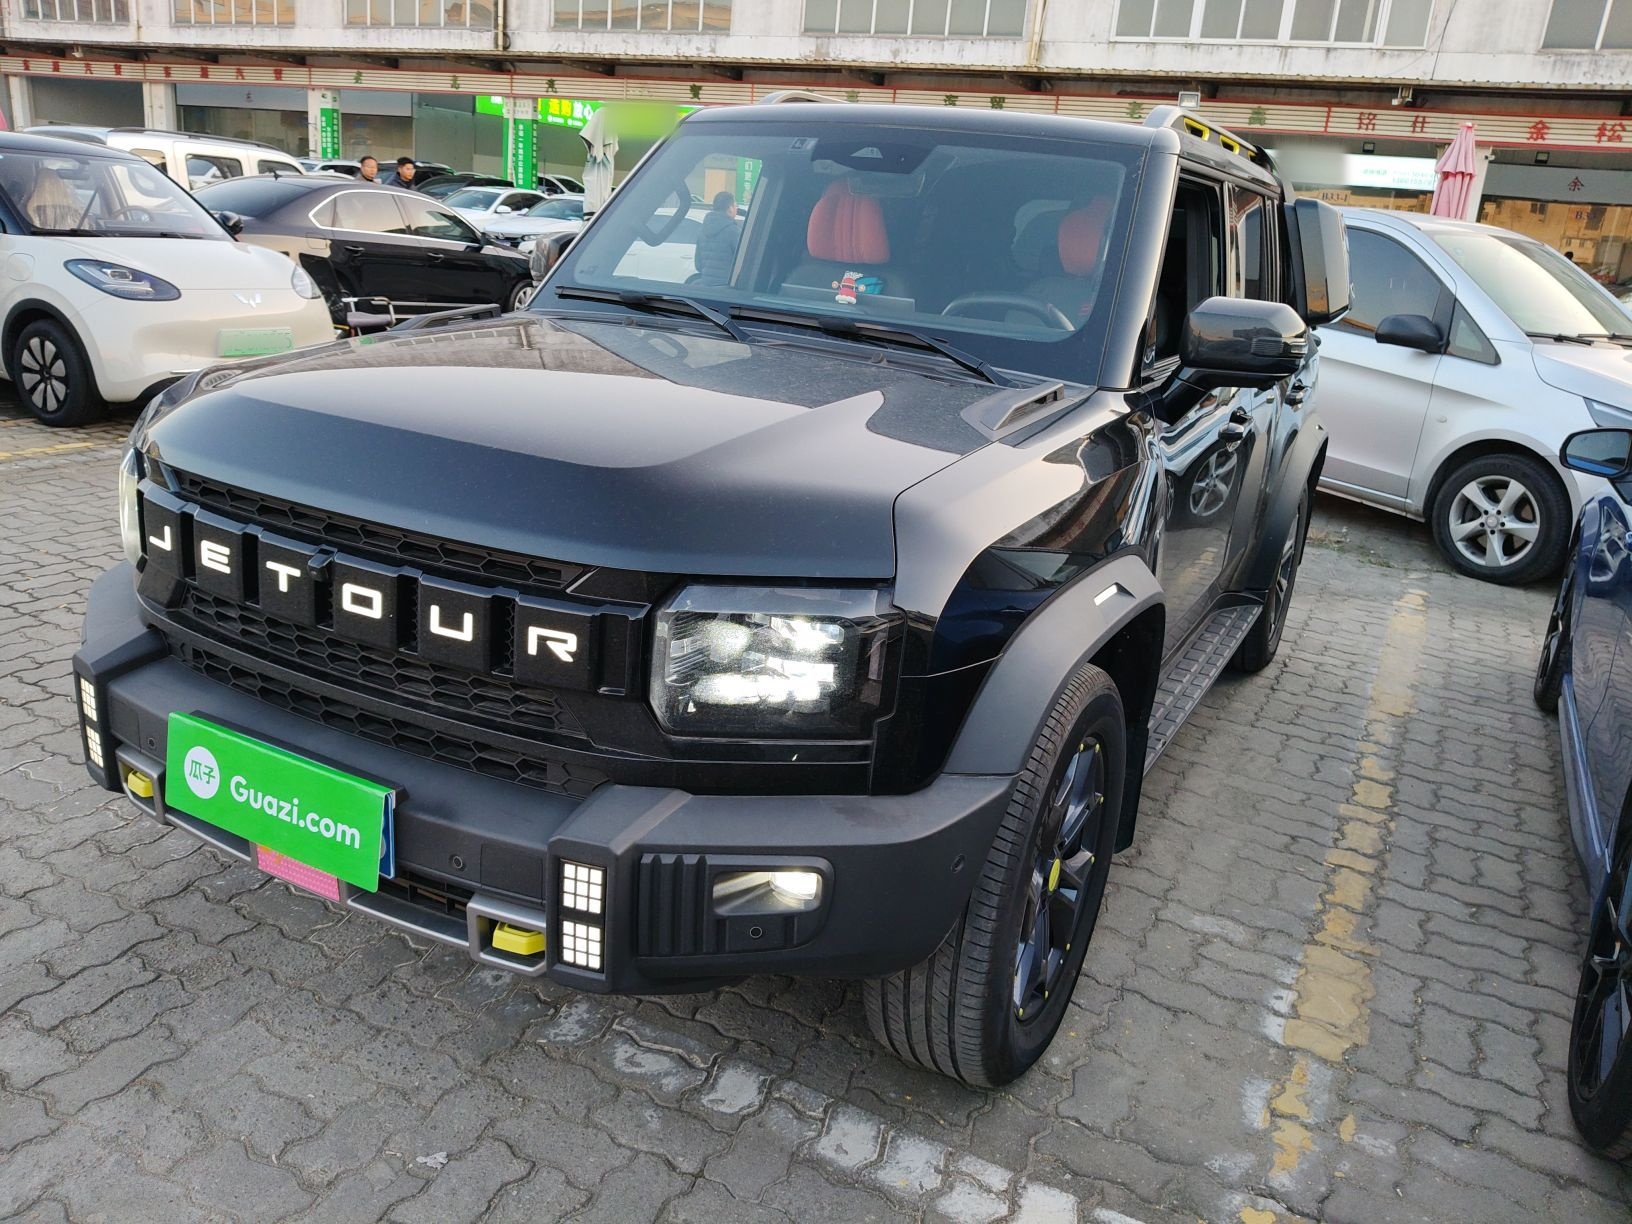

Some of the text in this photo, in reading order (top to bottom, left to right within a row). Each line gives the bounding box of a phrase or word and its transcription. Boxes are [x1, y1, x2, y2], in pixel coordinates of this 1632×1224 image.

[148, 525, 578, 662] JETOUR
[189, 759, 216, 785] 瓜子
[230, 775, 361, 849] Guazi.com
